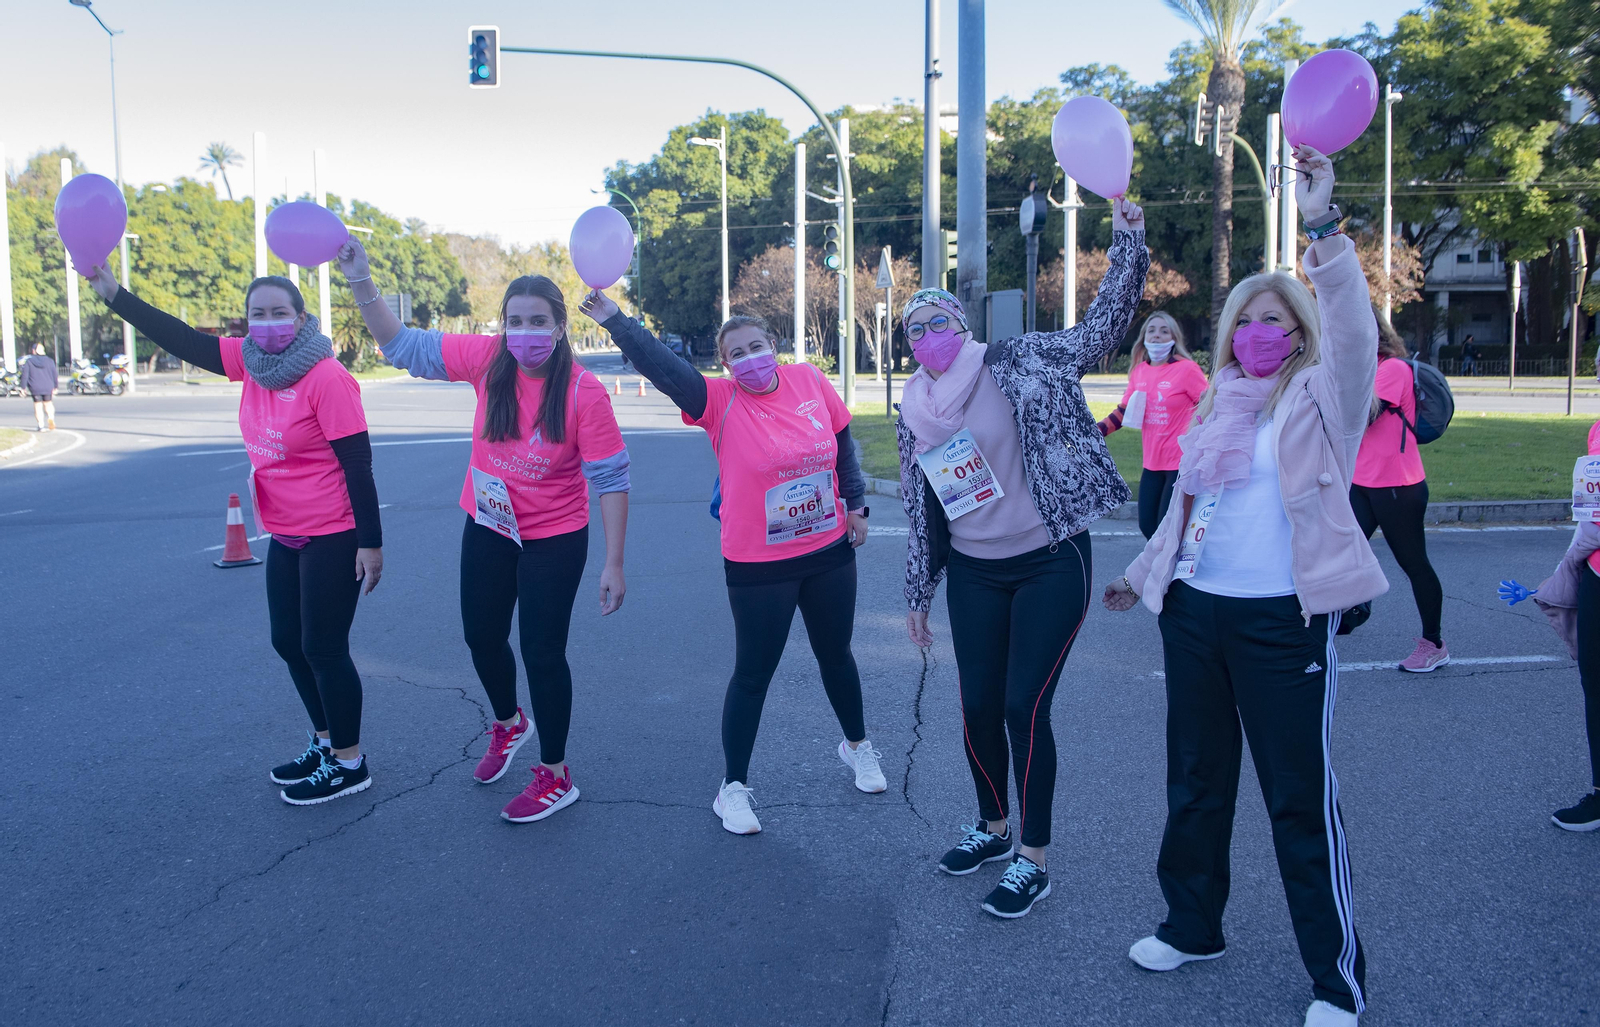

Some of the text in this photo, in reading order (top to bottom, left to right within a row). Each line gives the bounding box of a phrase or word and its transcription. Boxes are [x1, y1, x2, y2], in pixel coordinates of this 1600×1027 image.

[266, 428, 283, 441] POR
[257, 435, 284, 451] TODAS
[815, 440, 832, 451] POR
[511, 456, 546, 473] TODAS
[527, 452, 550, 465] POR
[803, 452, 834, 465] TODAS
[488, 454, 544, 481] NOSOTRAS
[778, 463, 831, 479] NOSOTRAS
[954, 457, 983, 479] 016
[968, 473, 984, 486] 1537
[786, 488, 814, 501] ASTURIANA
[488, 498, 511, 516] 016
[788, 500, 816, 518] 016
[950, 499, 974, 514] OYSHO
